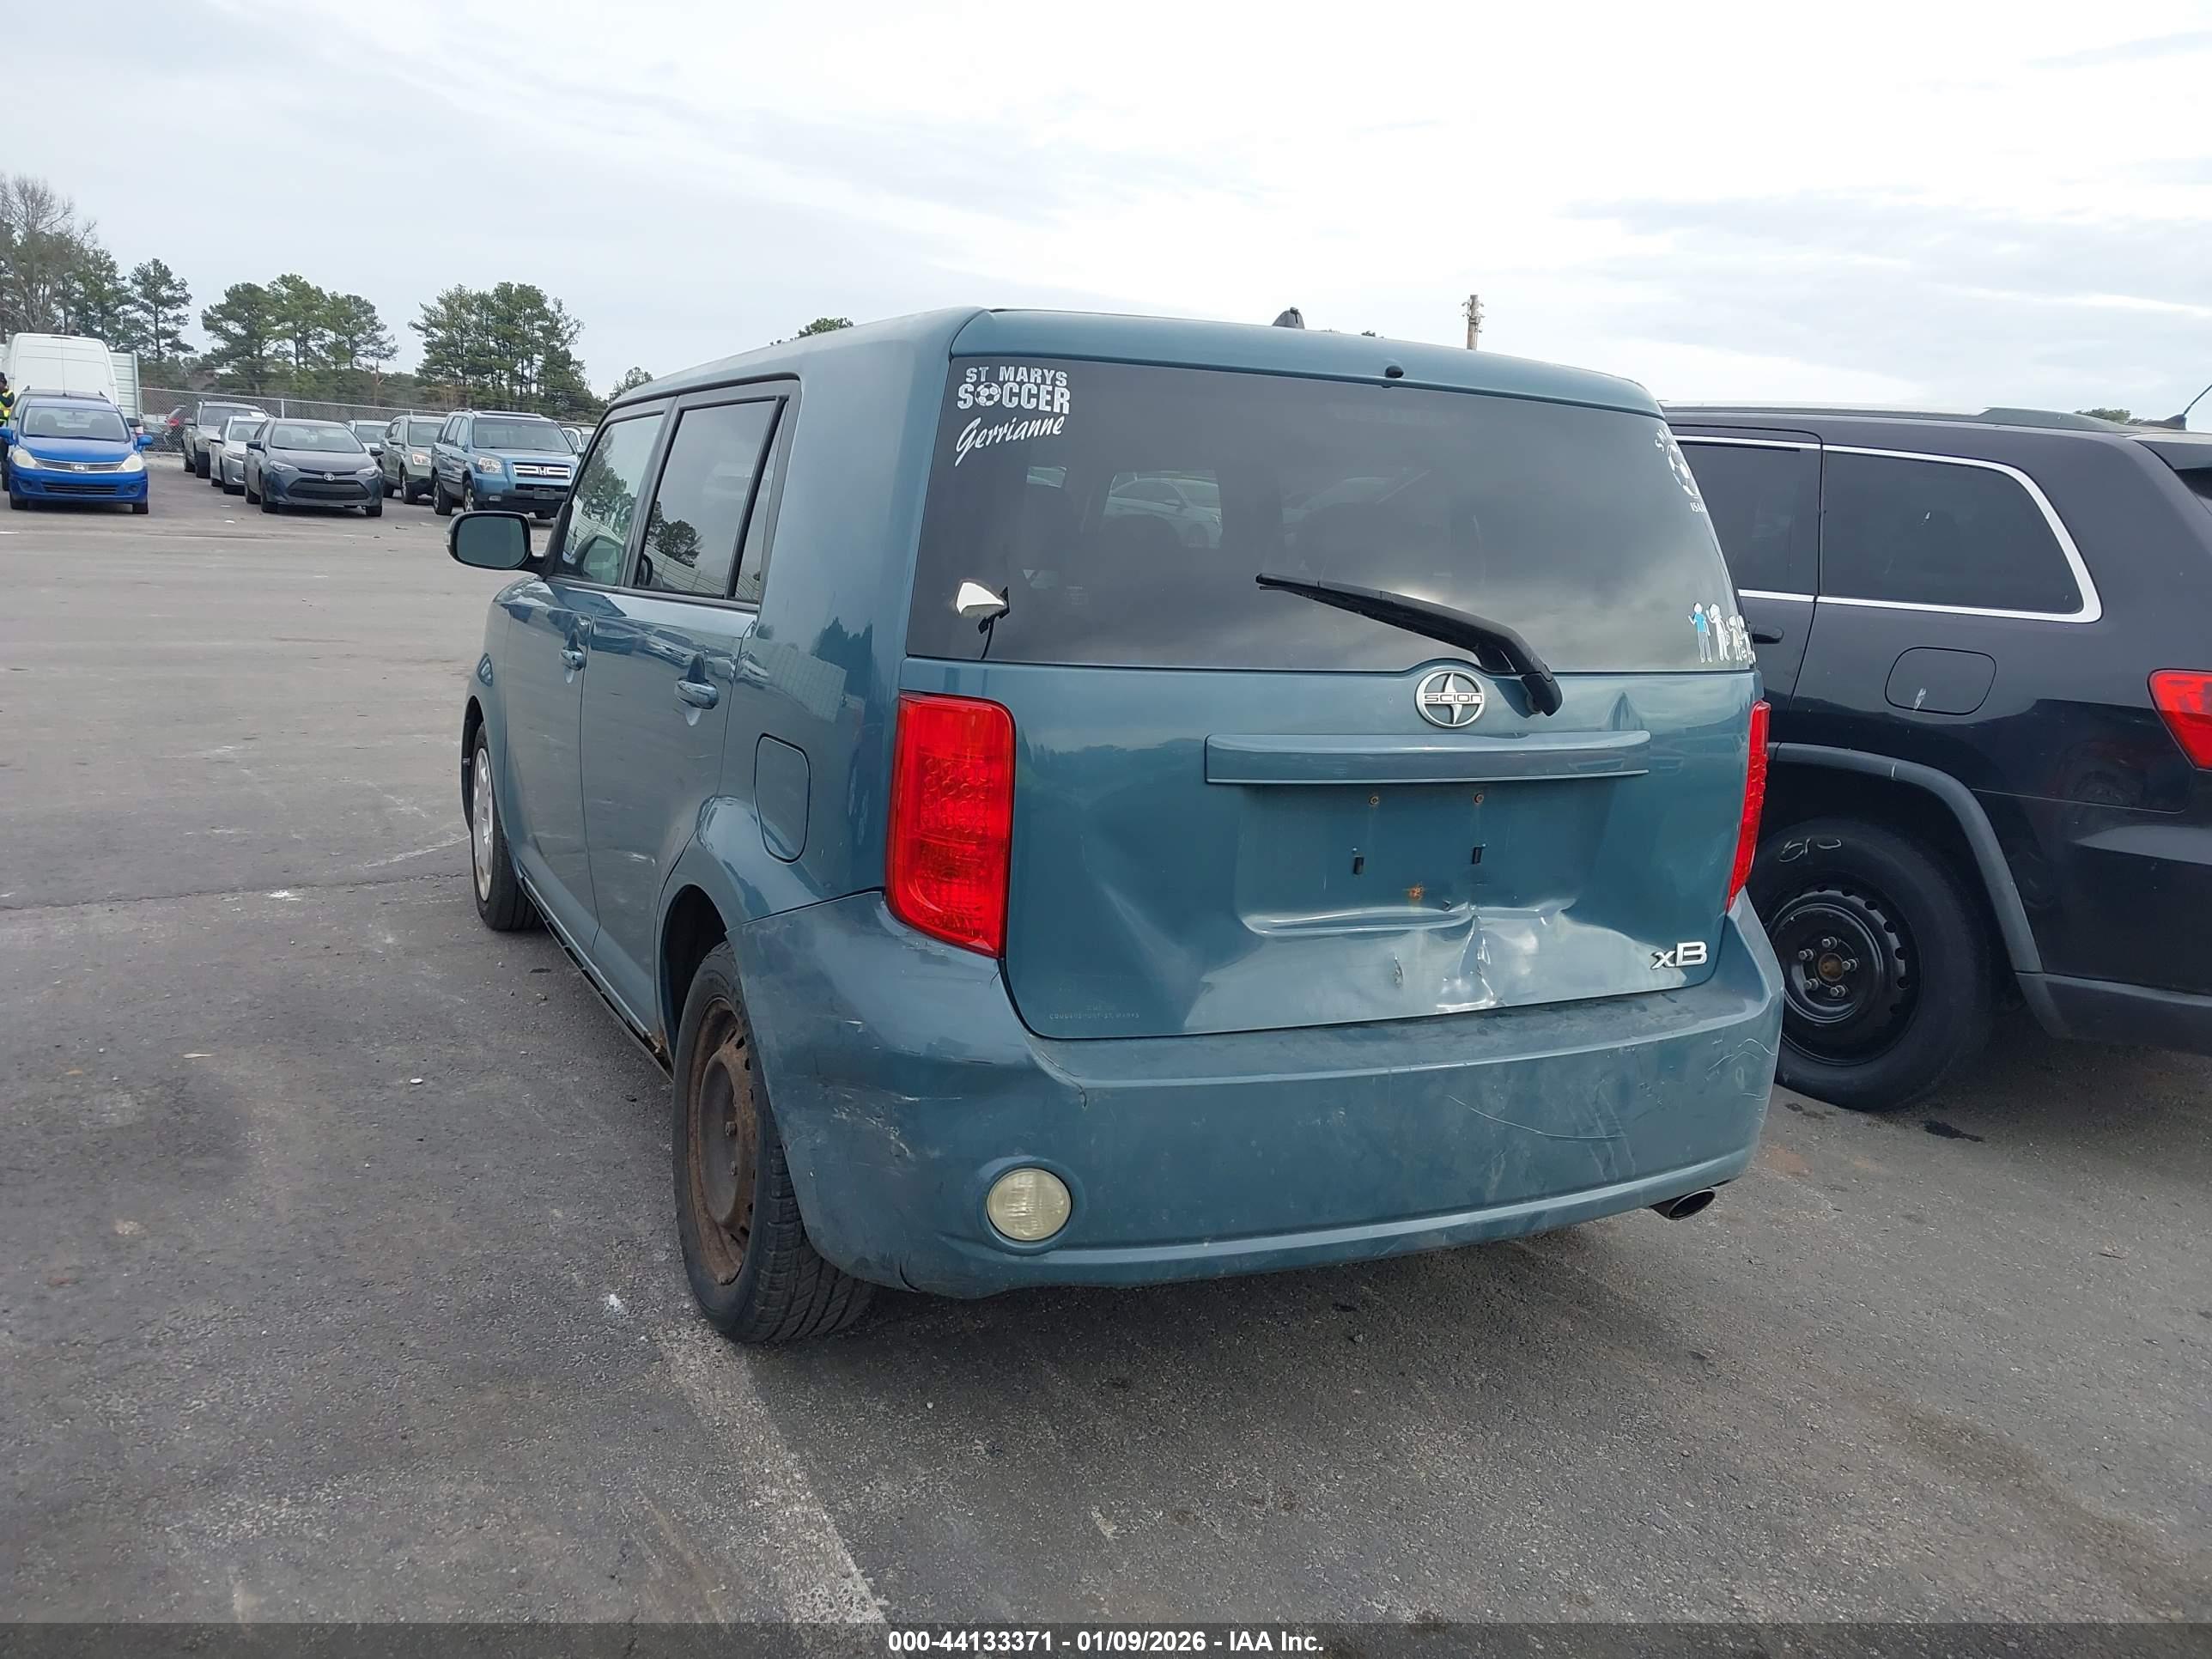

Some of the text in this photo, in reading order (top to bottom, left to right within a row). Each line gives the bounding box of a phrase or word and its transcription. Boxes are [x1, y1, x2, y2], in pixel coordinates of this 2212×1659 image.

[965, 366, 1068, 387] ST MARYS
[955, 416, 1066, 467] Gerrianne
[1424, 694, 1483, 702] SCION
[1650, 941, 1708, 969] xB
